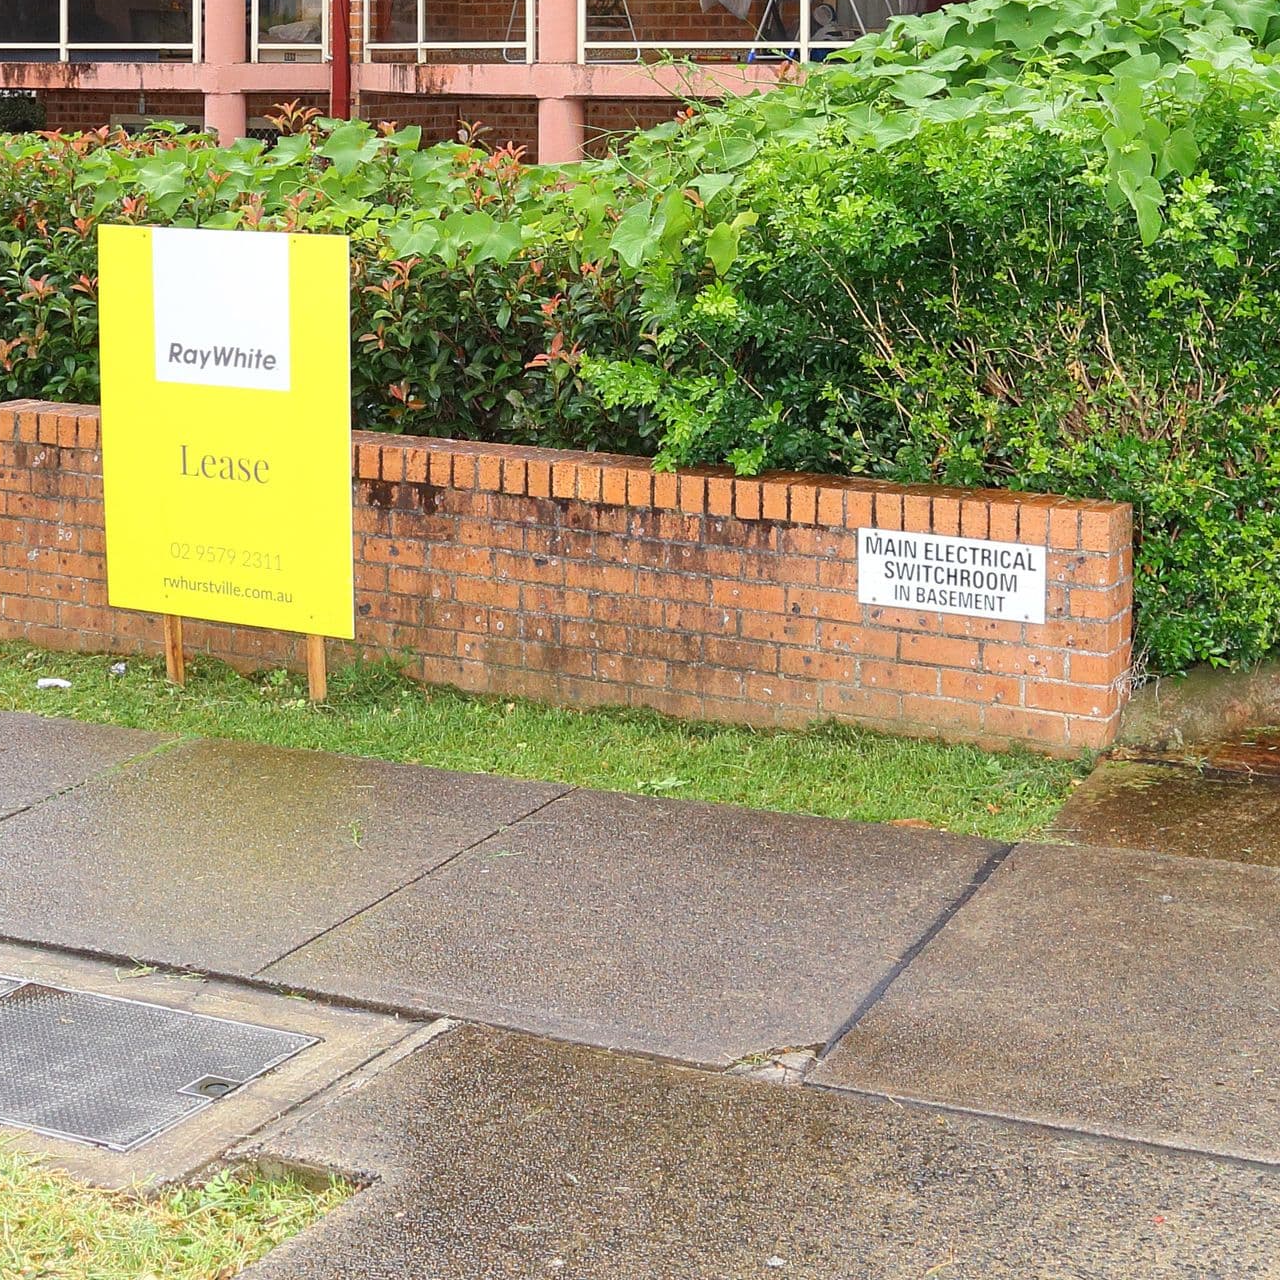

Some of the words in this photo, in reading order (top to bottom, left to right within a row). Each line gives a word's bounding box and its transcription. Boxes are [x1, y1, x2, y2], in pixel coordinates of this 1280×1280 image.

[168, 343, 277, 371] RayWhite
[179, 445, 270, 484] Lease
[170, 542, 193, 561] 02
[196, 545, 236, 567] 9579
[241, 550, 282, 571] 2311
[865, 536, 917, 558] MAIN
[924, 542, 1037, 572] ELECTRICAL
[164, 576, 293, 604] rwhurstville.com.au
[884, 561, 1018, 593] SWITCHROOM
[894, 585, 910, 602] IN
[916, 587, 1006, 613] BASEMENT
